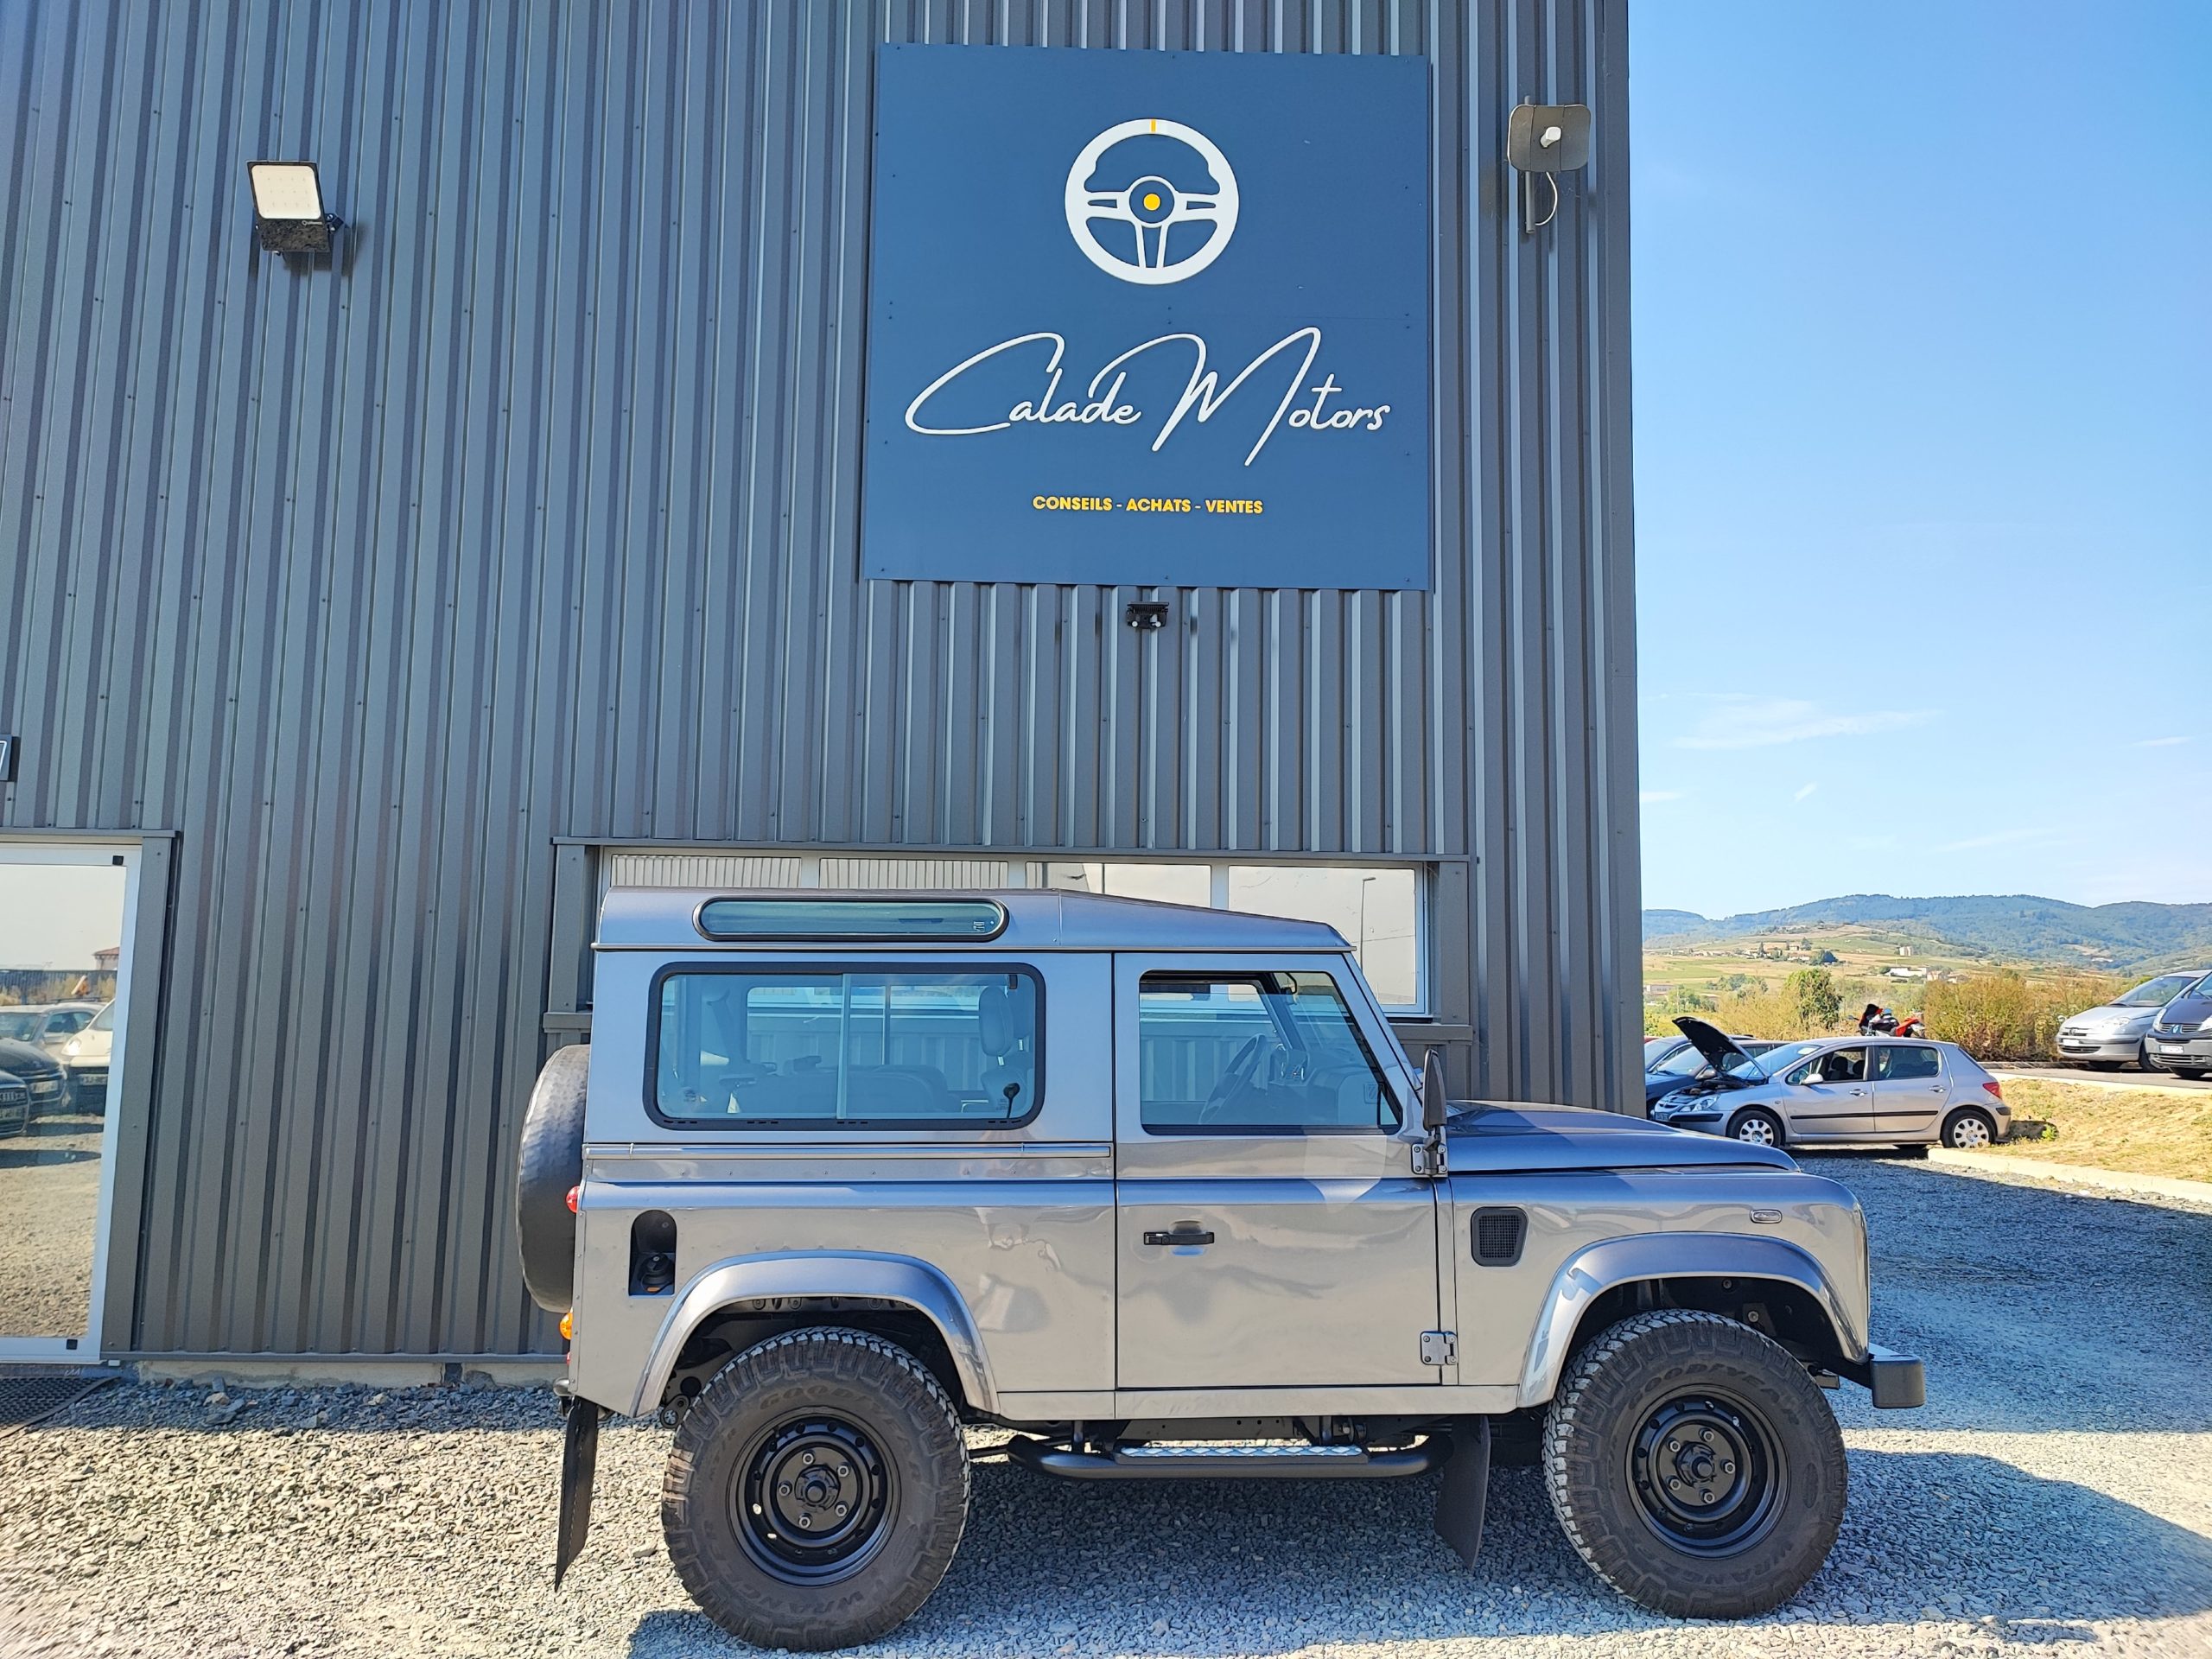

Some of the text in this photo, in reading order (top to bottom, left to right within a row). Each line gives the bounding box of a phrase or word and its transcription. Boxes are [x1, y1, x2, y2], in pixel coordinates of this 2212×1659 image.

[905, 326, 1392, 467] Calade Motors
[1032, 495, 1113, 512] CONSEILS
[1126, 498, 1192, 513] ACHATS
[1205, 499, 1264, 514] VENTES
